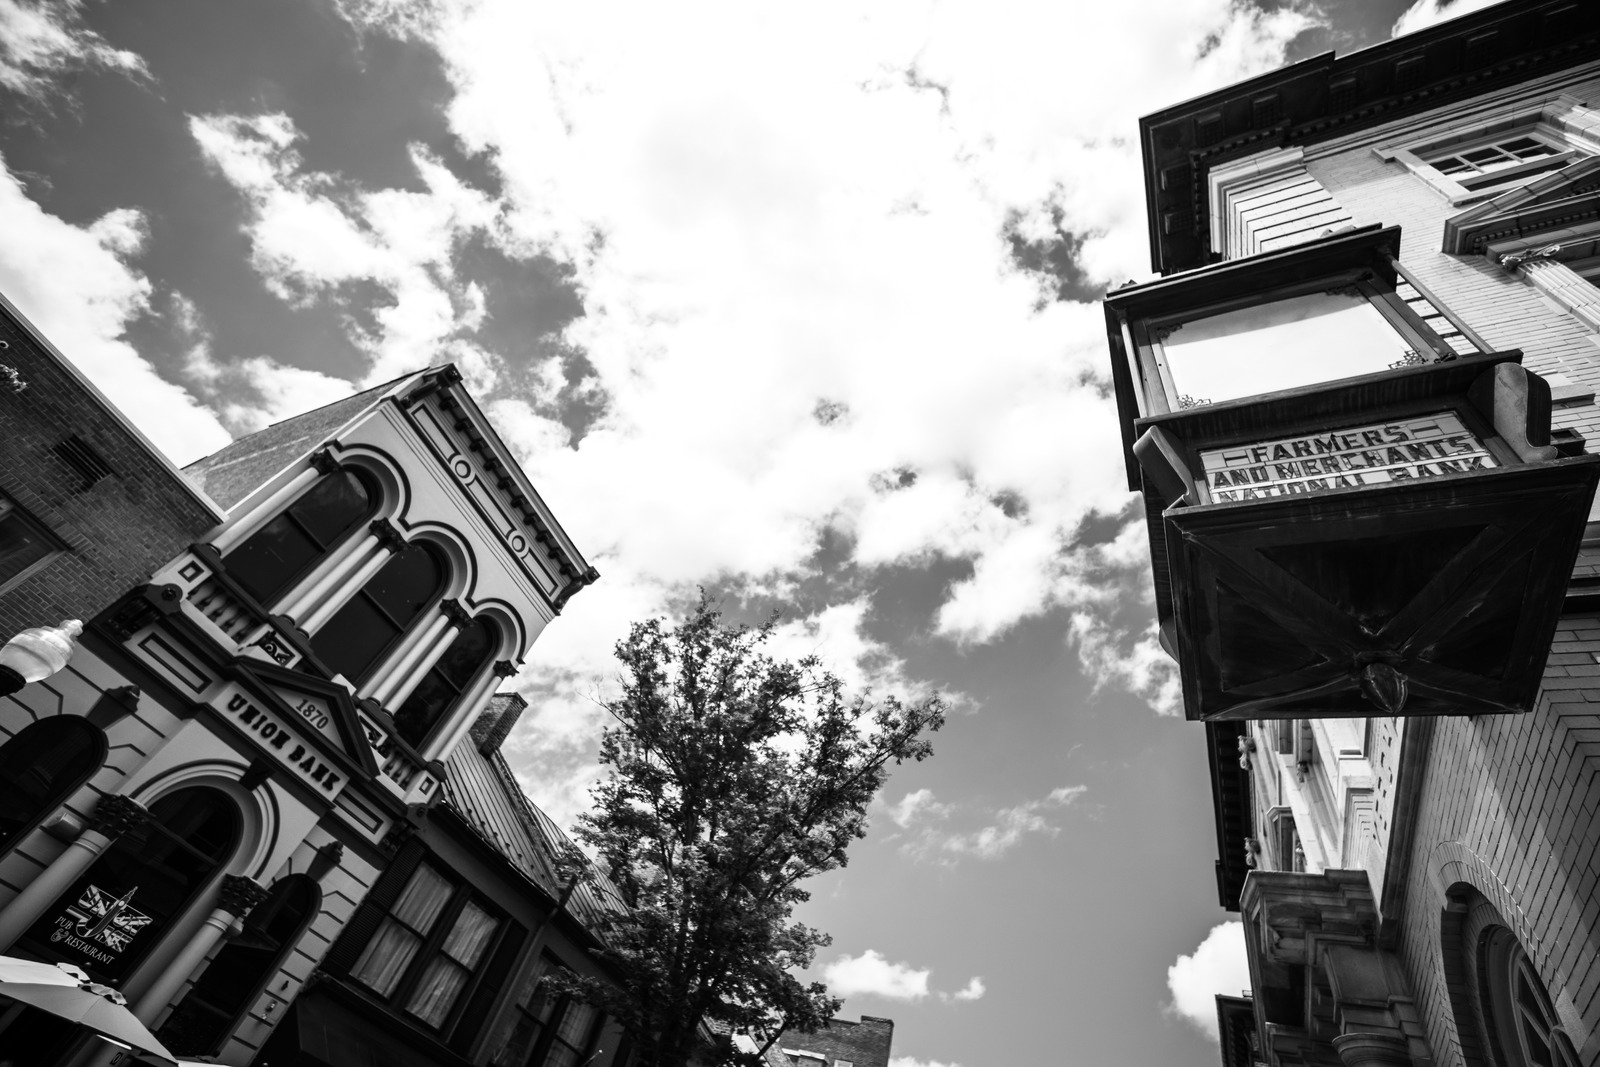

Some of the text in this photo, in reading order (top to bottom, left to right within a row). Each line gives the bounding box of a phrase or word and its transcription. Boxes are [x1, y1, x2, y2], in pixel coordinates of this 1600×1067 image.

[1251, 425, 1410, 463] FARMERS
[1214, 436, 1475, 488] AND MERCHANTS
[295, 698, 330, 730] 1870
[227, 692, 341, 792] UNION BANK
[54, 915, 75, 931] PUB
[64, 934, 116, 965] RESTAURANT
